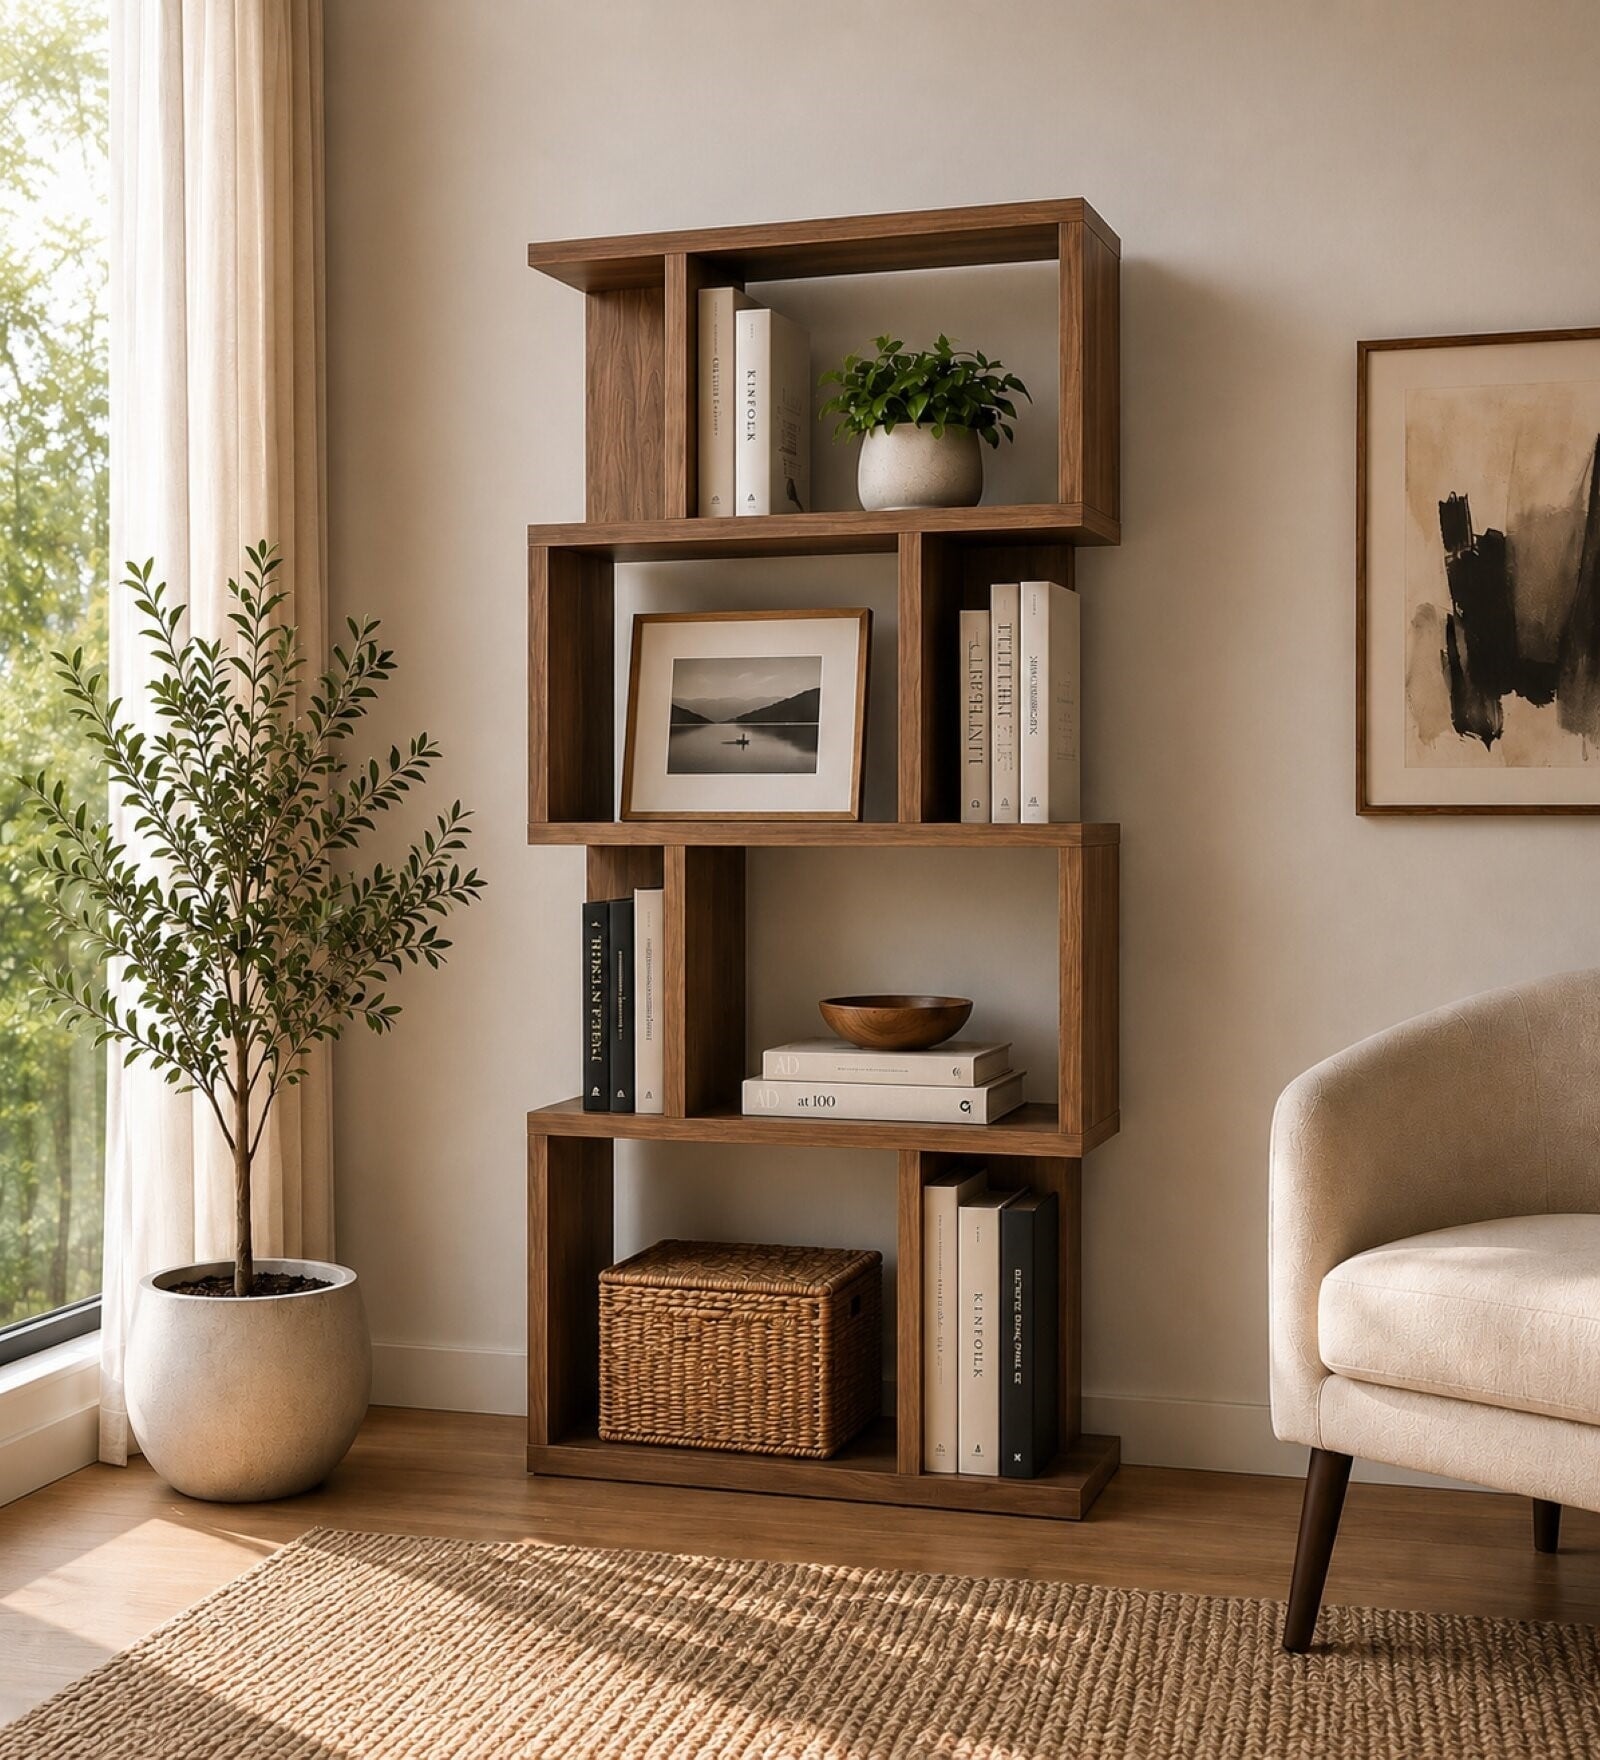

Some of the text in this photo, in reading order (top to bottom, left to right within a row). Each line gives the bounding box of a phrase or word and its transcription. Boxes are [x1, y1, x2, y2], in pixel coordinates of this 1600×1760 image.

[747, 370, 756, 441] KINFOLK
[773, 1056, 799, 1075] AD
[753, 1089, 779, 1109] AD
[797, 1096, 809, 1107] at
